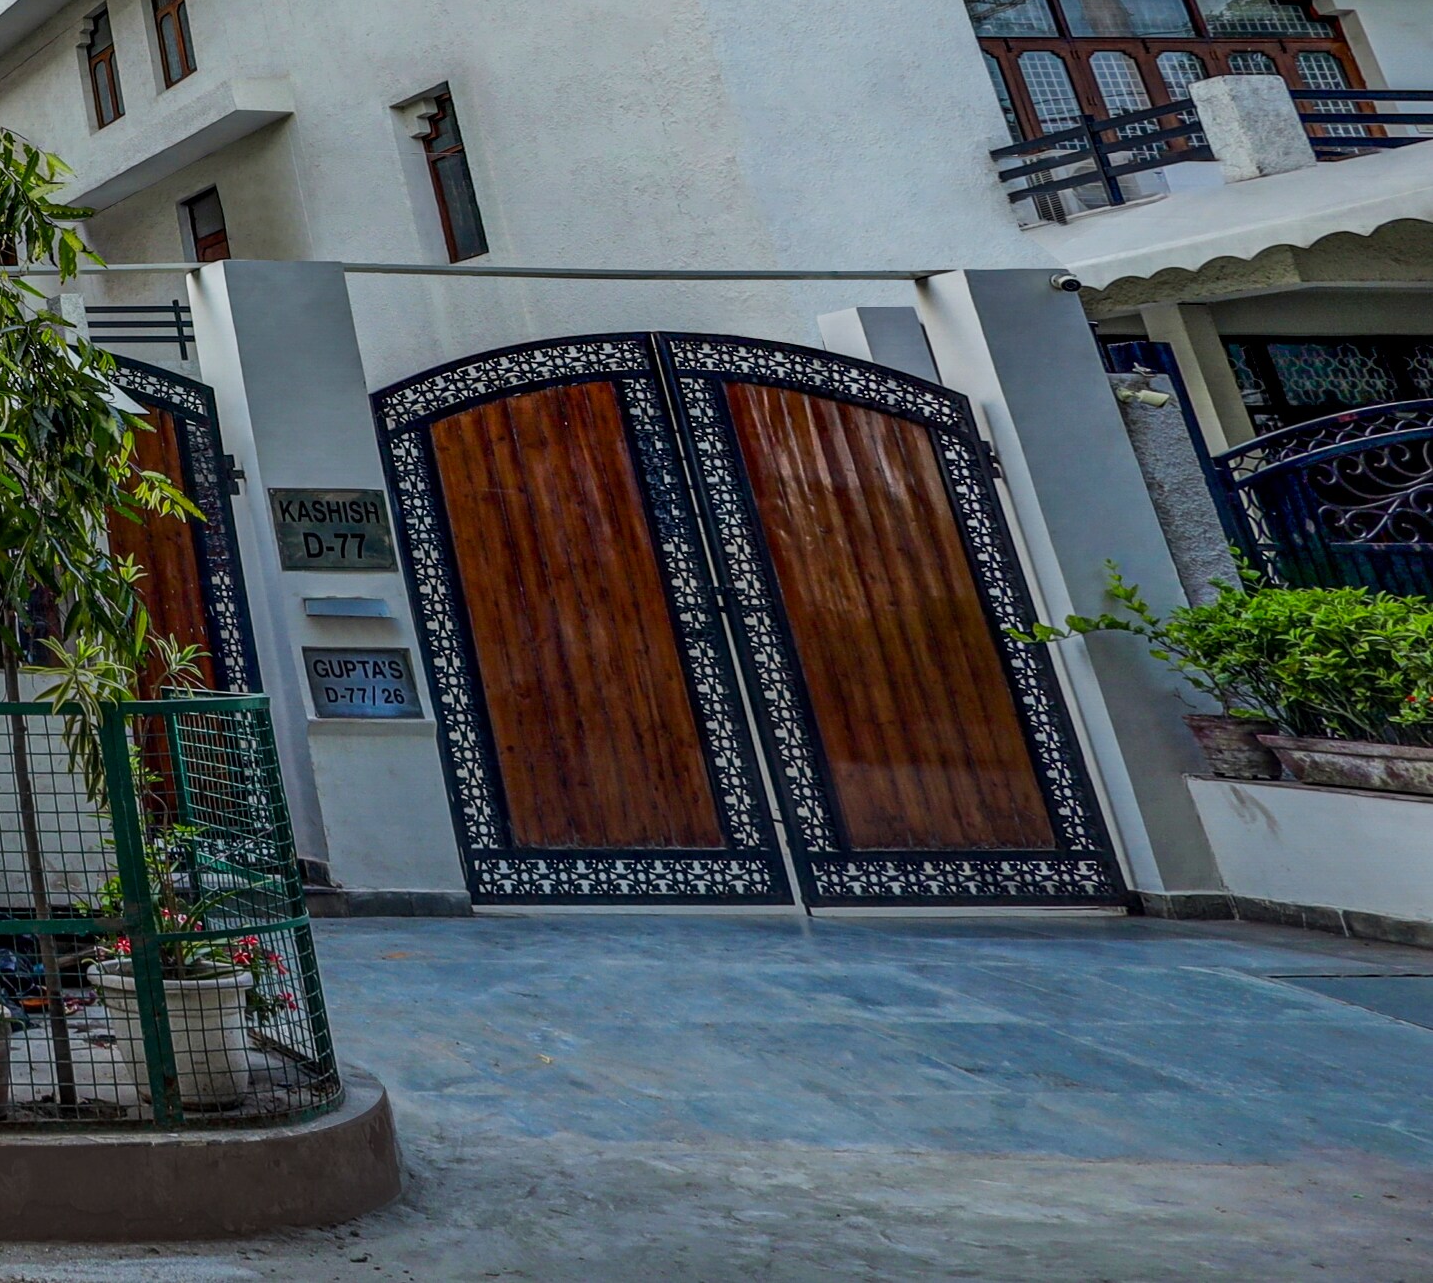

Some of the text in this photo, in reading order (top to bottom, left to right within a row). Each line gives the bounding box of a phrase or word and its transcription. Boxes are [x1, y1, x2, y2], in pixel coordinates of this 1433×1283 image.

[278, 500, 381, 524] KASHISH
[302, 532, 366, 559] D-77
[313, 659, 404, 679] GUPTA'S
